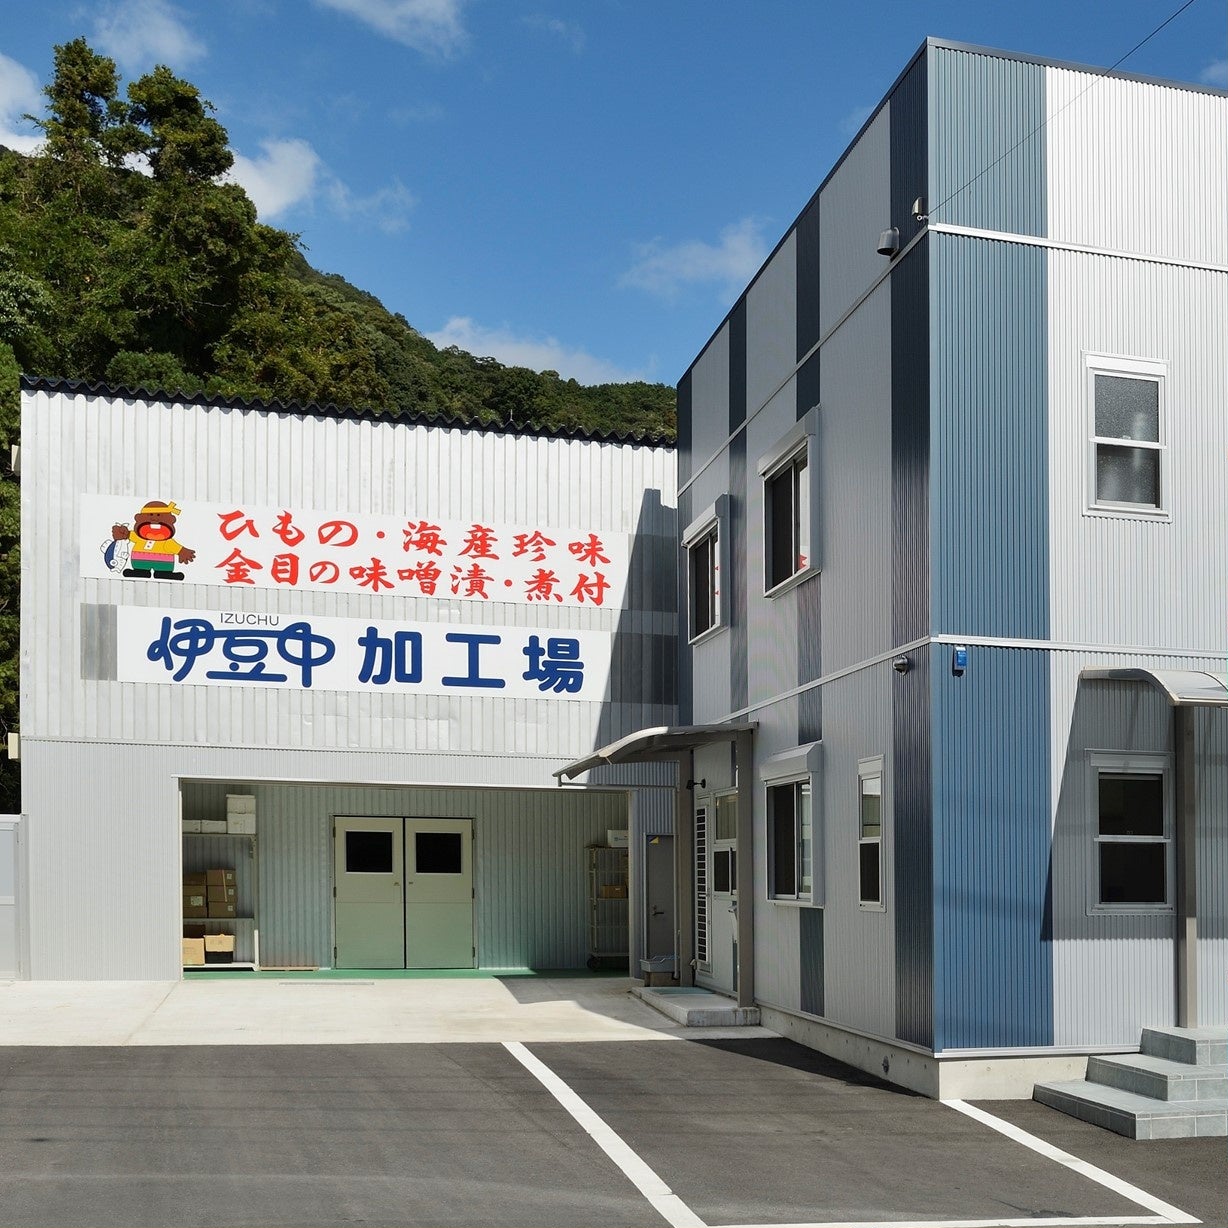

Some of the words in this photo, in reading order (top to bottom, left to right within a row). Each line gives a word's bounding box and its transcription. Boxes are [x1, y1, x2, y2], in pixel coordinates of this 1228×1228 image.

[217, 509, 612, 566] ひもの・海産珍味
[215, 548, 612, 607] 金目の味噌漬・煮付
[219, 613, 280, 627] IZUCHU
